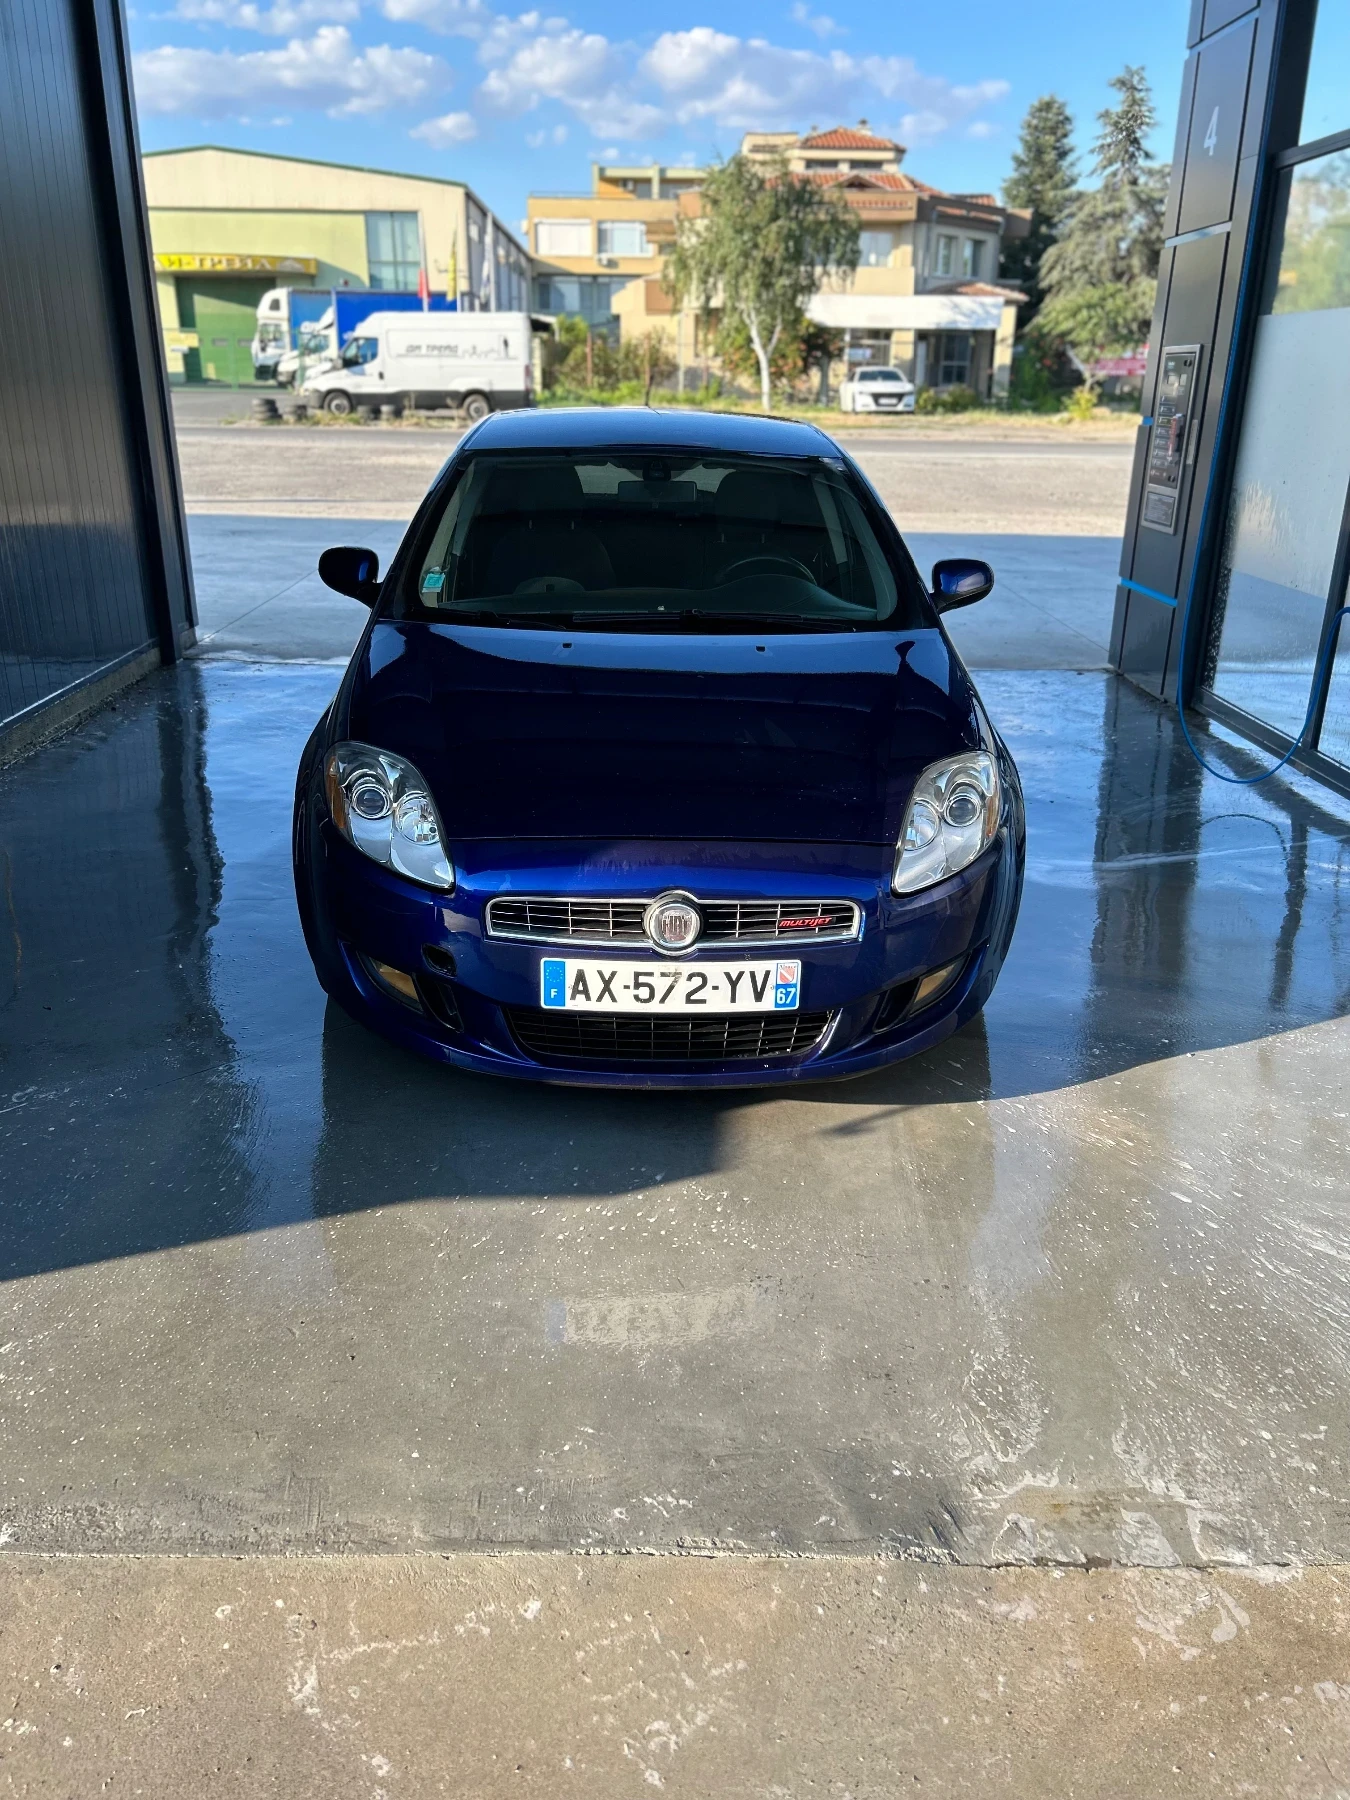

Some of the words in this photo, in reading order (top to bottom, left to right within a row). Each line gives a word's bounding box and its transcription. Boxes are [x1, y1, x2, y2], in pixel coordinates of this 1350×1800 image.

[1203, 105, 1220, 157] 4
[778, 916, 833, 927] MULTIJET
[550, 988, 558, 999] F
[569, 968, 772, 1005] AX-572-YV
[776, 987, 797, 1005] 67
